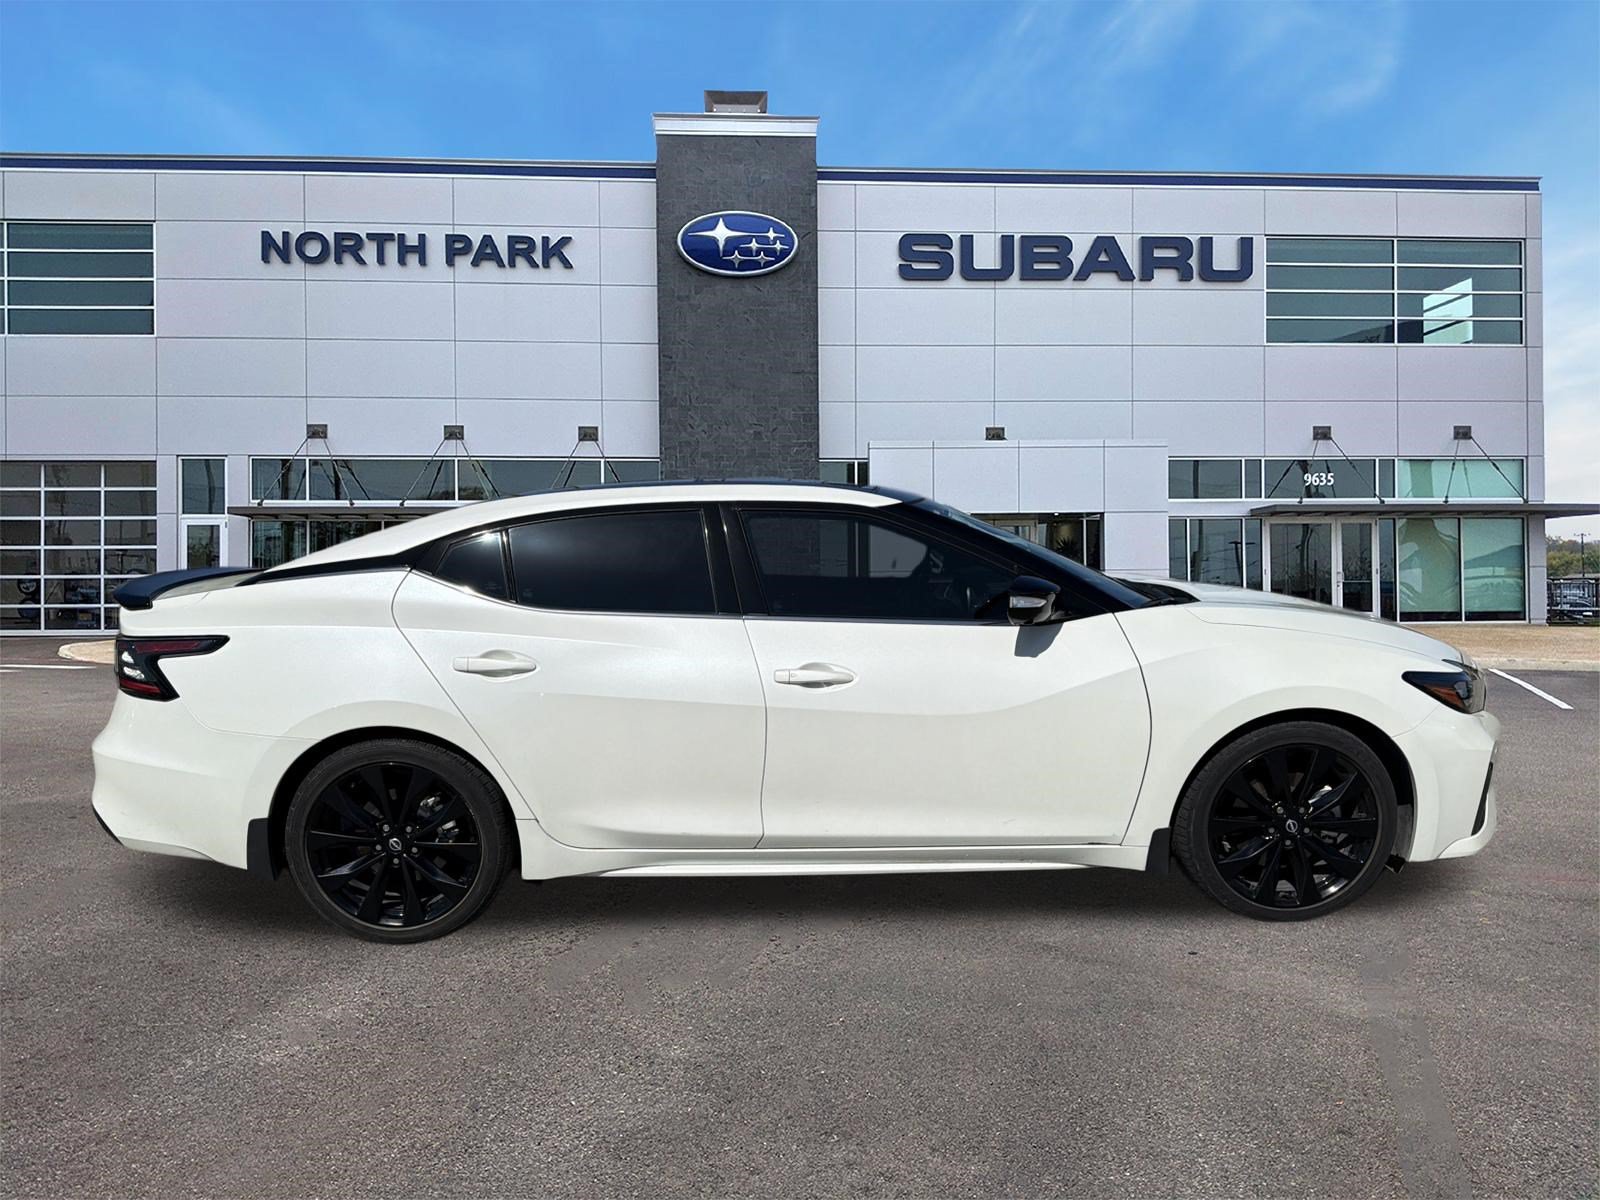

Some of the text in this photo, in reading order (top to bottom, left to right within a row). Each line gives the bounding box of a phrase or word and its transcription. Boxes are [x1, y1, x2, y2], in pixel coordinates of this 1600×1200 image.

[261, 230, 574, 269] NORTH PARK
[898, 232, 1254, 283] SUBARU
[1303, 472, 1335, 487] 9635
